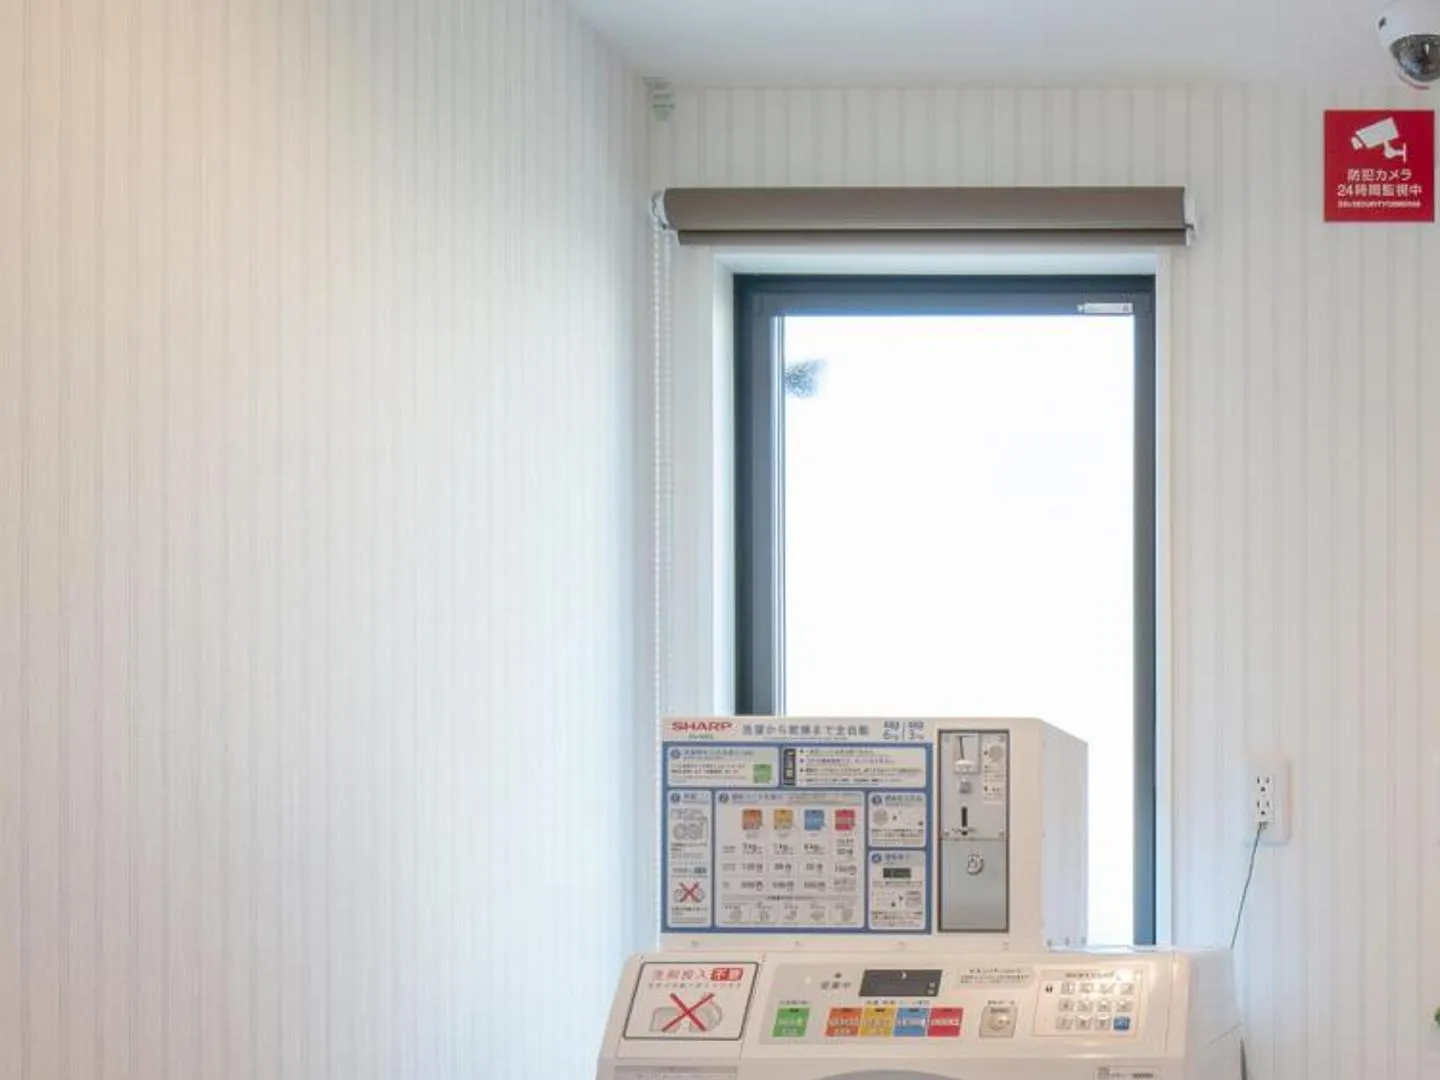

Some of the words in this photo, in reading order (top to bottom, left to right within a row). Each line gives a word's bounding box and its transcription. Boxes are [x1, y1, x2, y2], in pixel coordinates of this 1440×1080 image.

[1347, 168, 1412, 181] 防犯カメラ
[671, 721, 733, 732] SHARP
